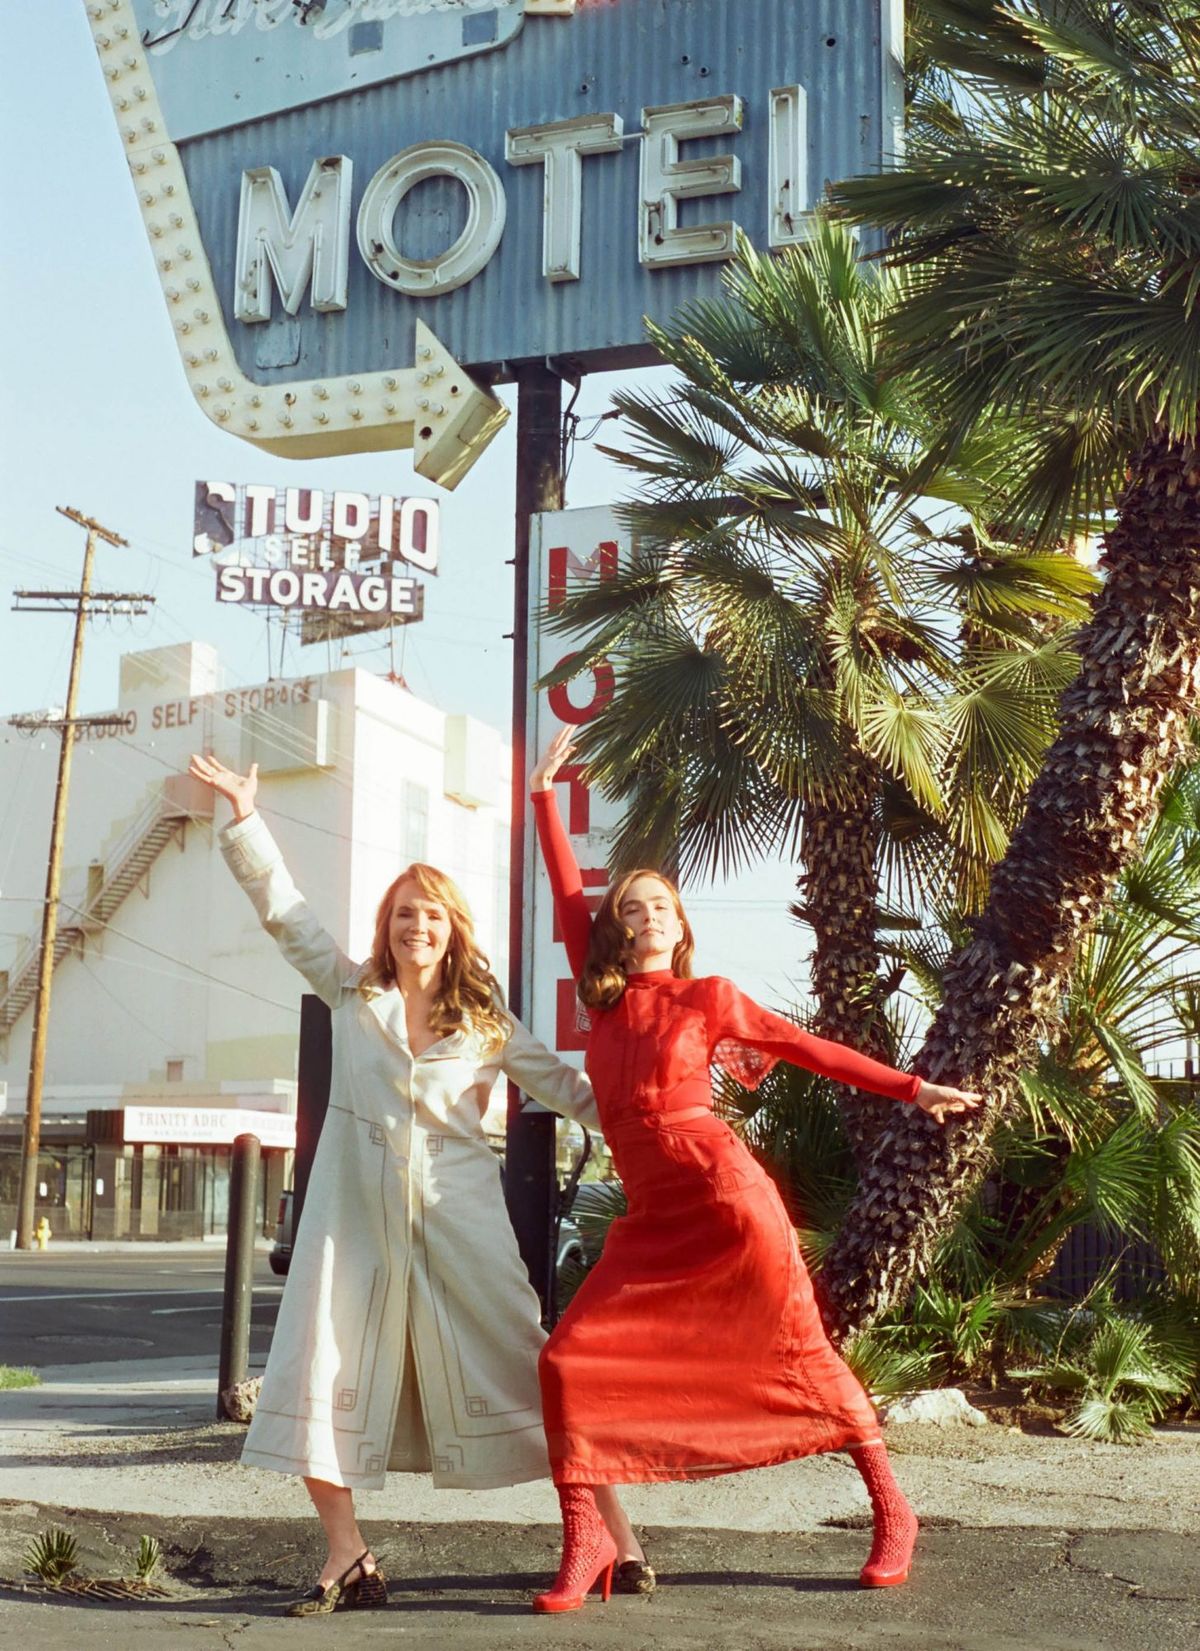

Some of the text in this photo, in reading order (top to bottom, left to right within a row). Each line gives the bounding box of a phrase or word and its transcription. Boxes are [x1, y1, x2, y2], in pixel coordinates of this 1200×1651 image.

[234, 84, 860, 322] MOTEL
[264, 533, 362, 571] SELF
[220, 567, 415, 613] STORAGE
[152, 707, 200, 730] SELF
[138, 1111, 188, 1127] TRINITY
[192, 1113, 227, 1128] ADHC
